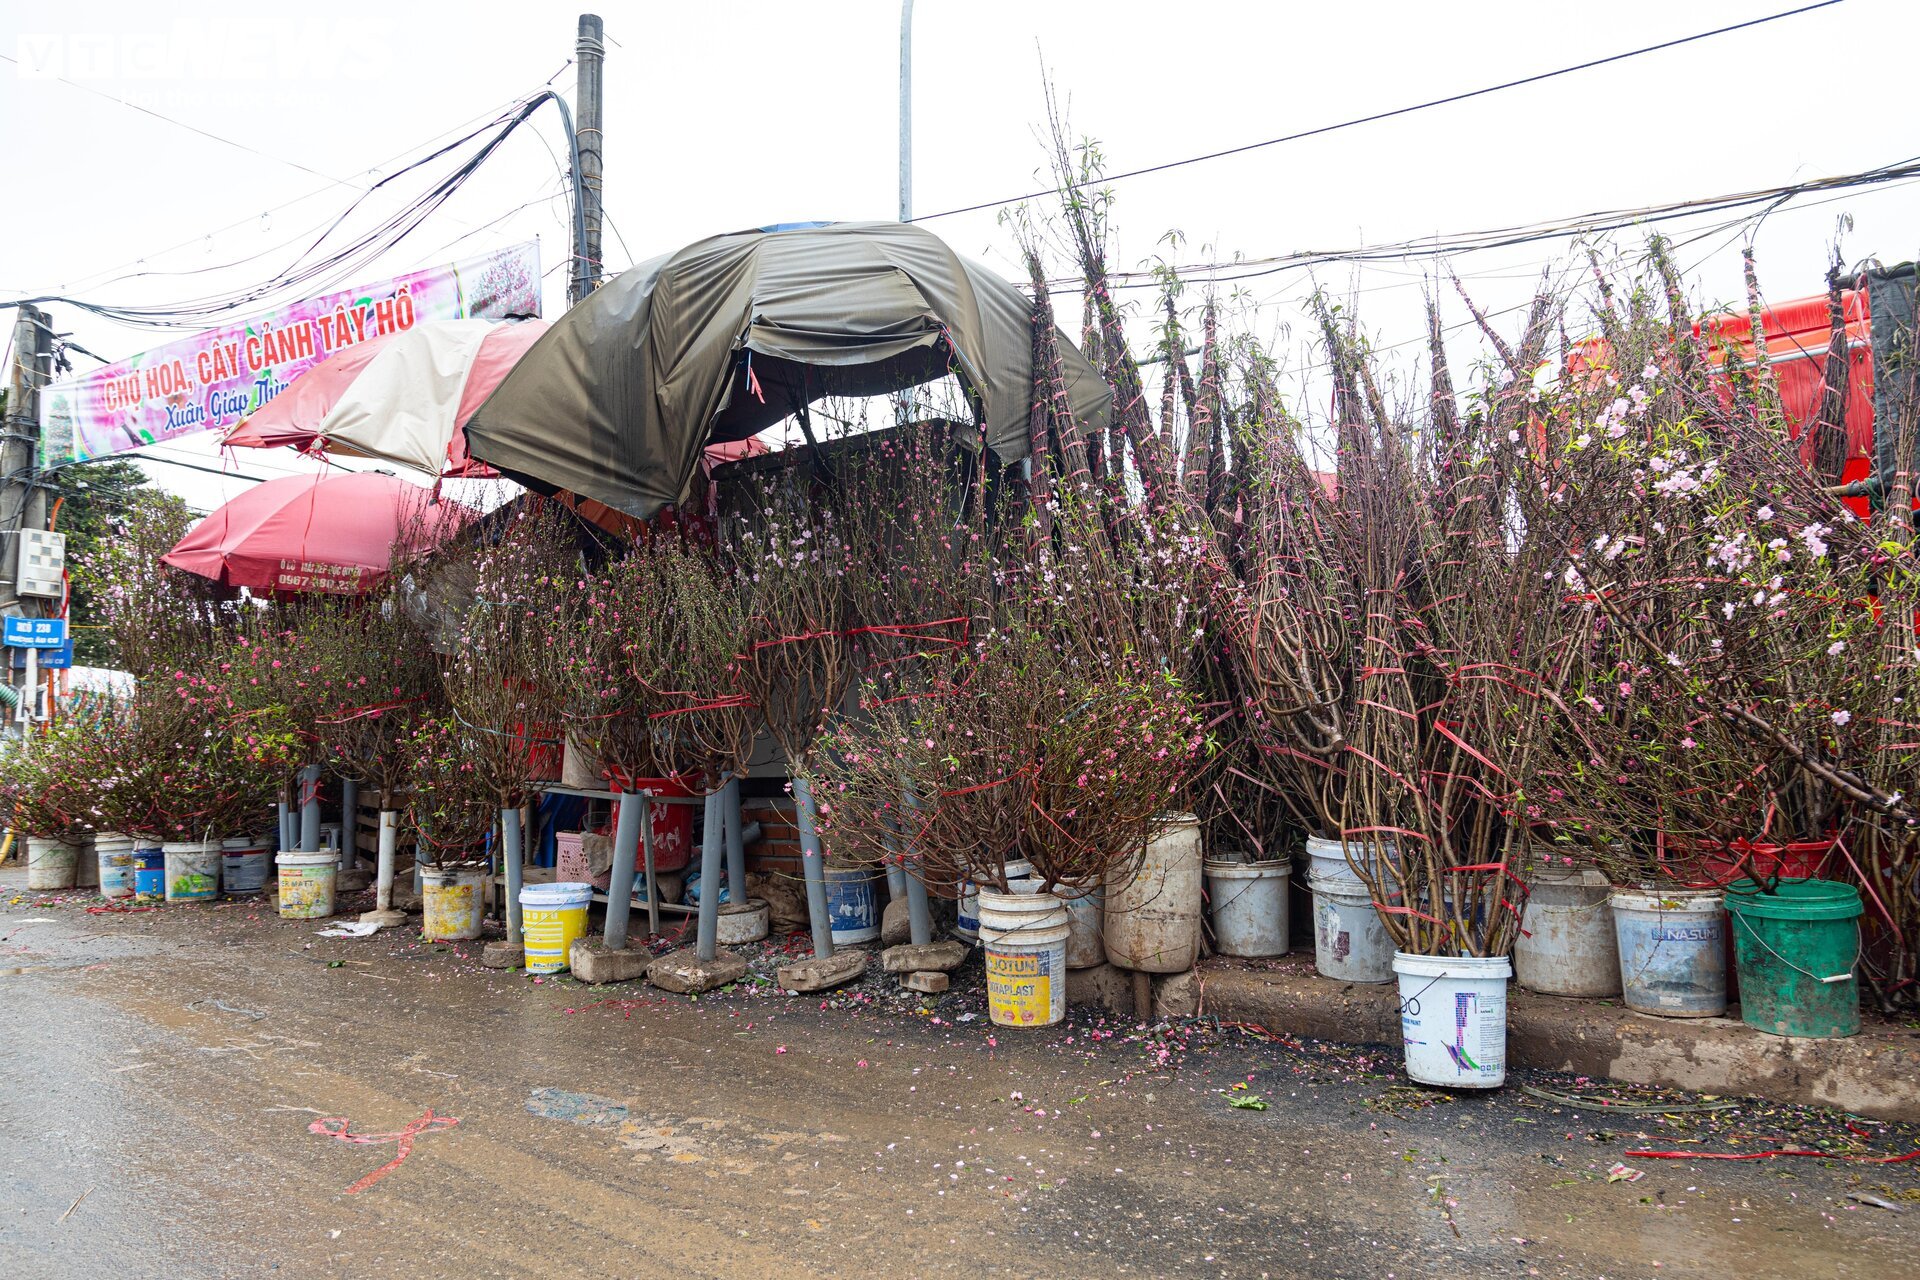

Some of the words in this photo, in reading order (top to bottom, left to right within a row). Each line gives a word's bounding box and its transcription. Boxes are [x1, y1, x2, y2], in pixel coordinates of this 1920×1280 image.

[105, 370, 141, 411] CHỢ
[147, 360, 193, 400] HOA,
[197, 341, 240, 384] CÂY
[247, 322, 314, 371] CẢNH
[319, 304, 366, 351] TÂY
[376, 283, 414, 335] HỒ
[165, 402, 205, 430] Xuân
[211, 389, 249, 424] Giáp
[279, 574, 309, 587] 0967
[993, 959, 1035, 972] JOTUN
